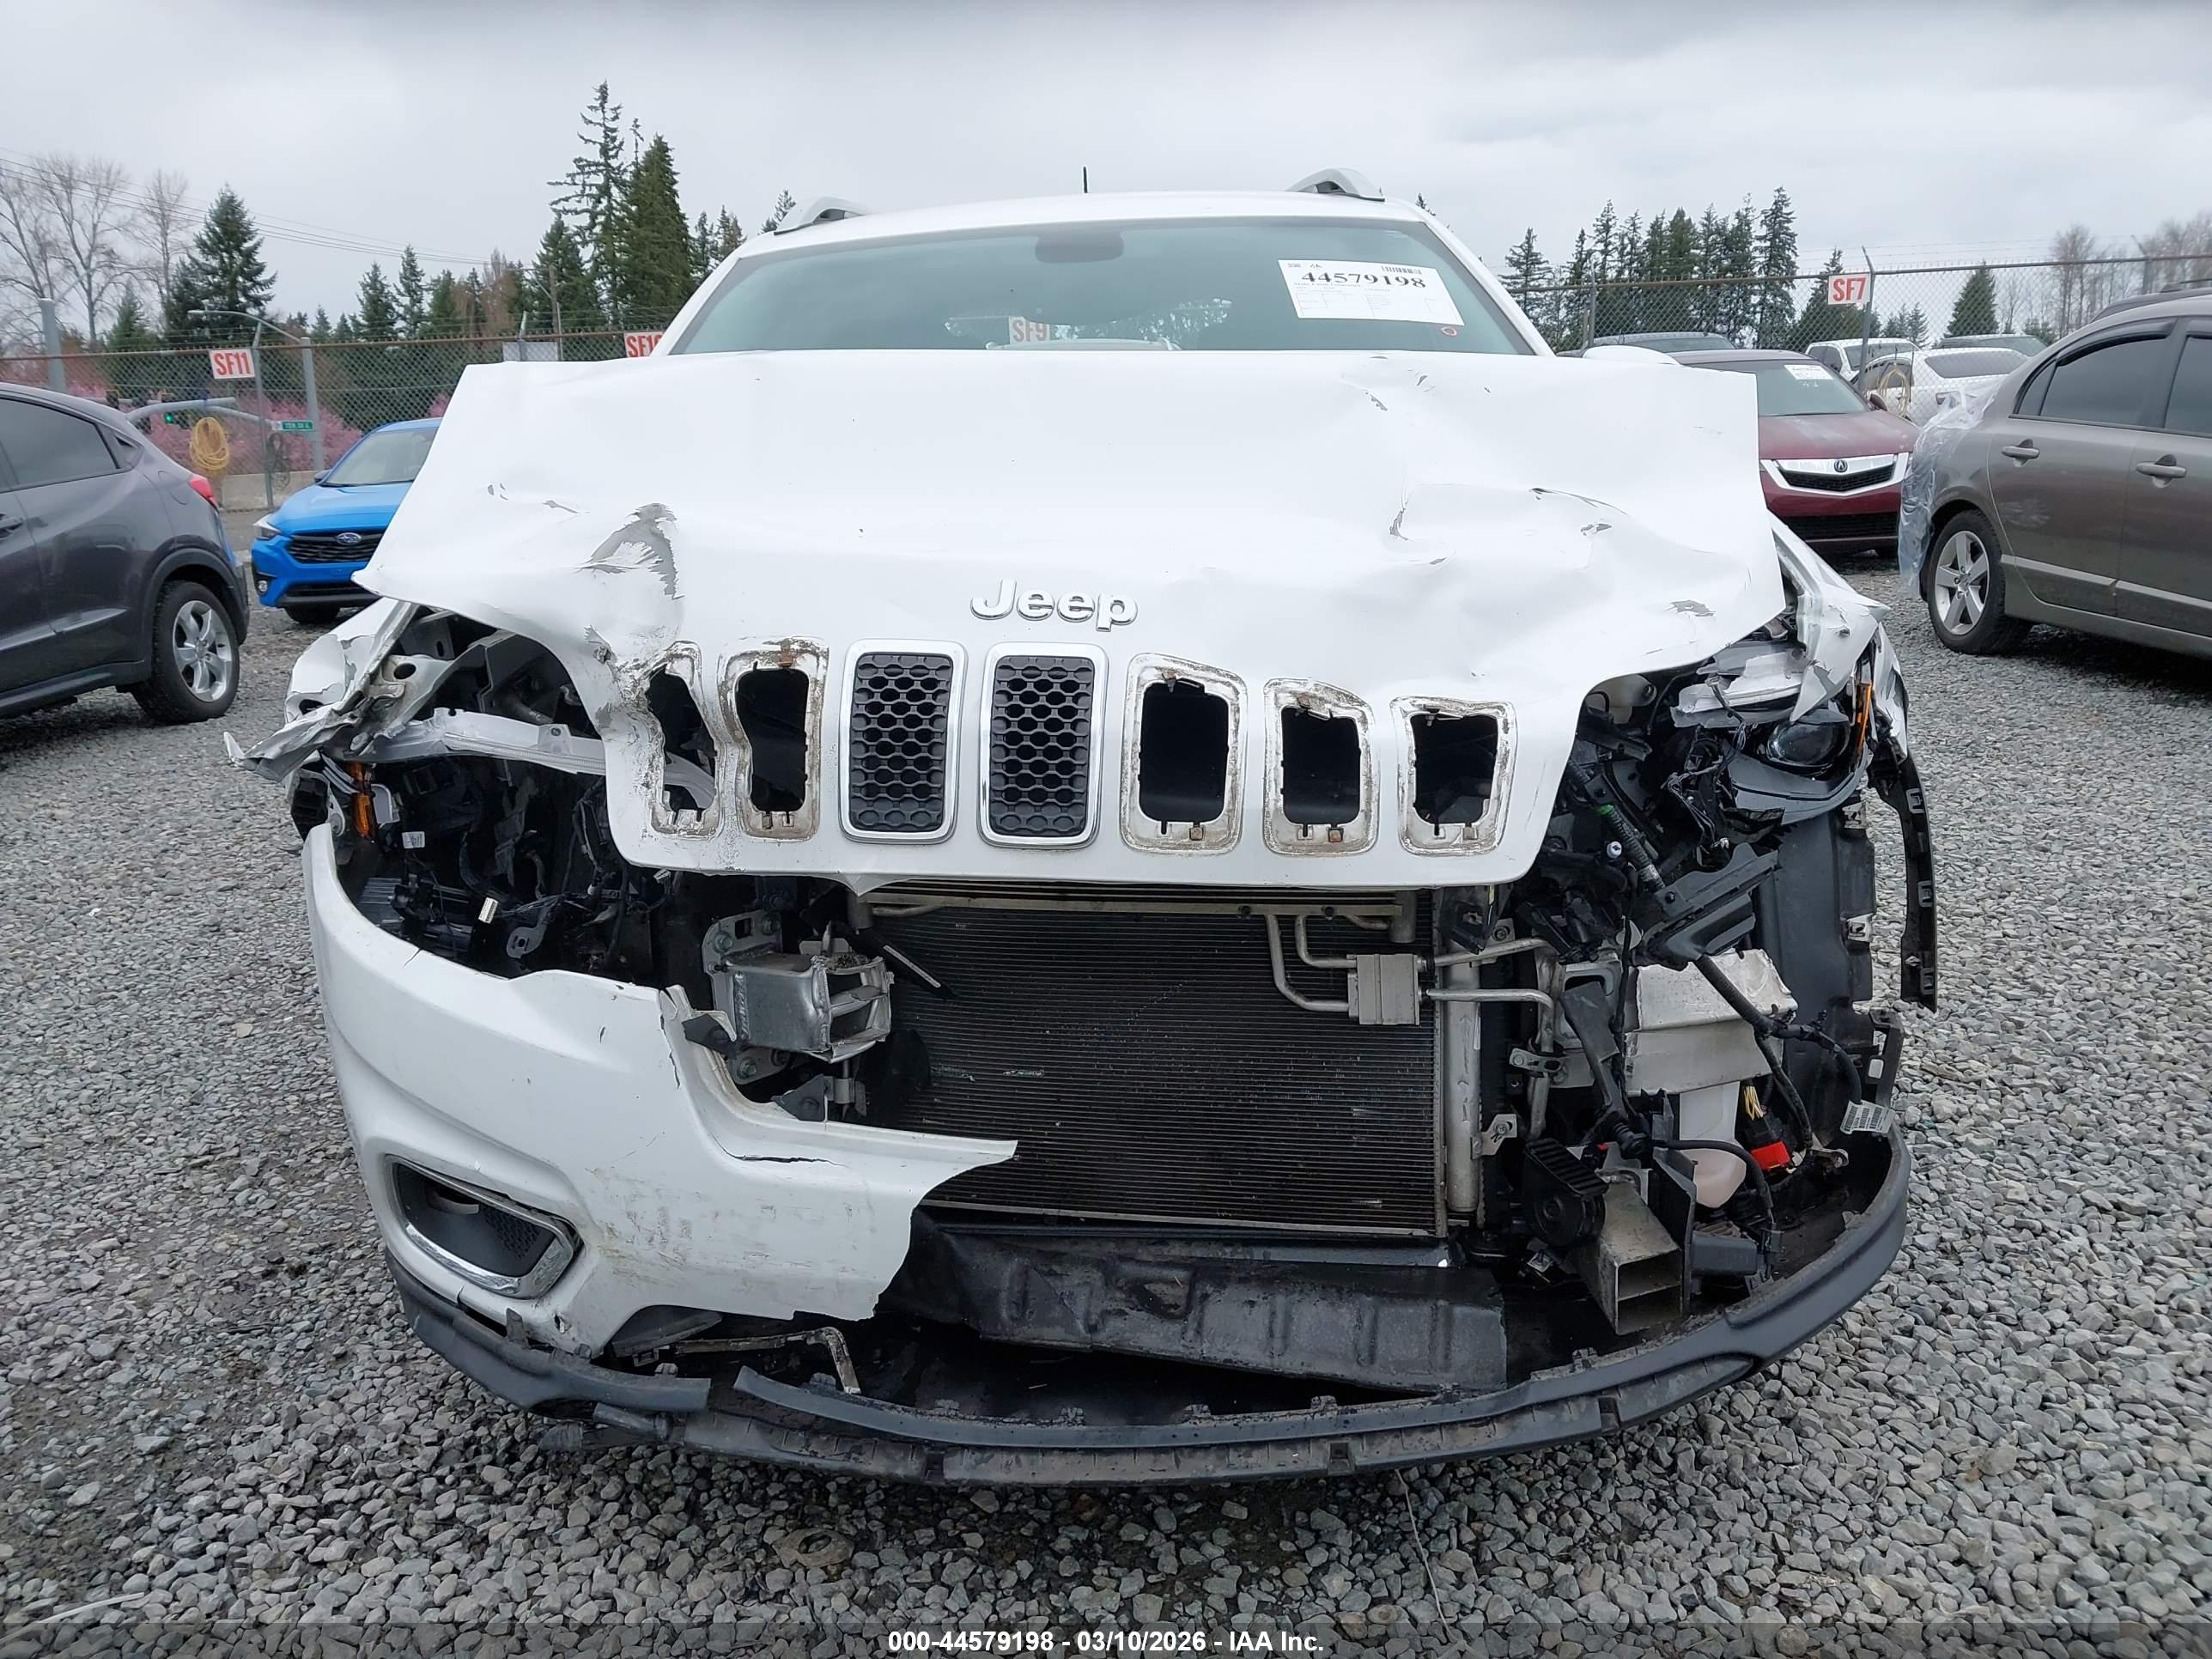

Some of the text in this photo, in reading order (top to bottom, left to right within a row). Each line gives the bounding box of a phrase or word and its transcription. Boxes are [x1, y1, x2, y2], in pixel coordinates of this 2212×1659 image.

[1301, 271, 1426, 288] 44579198
[1832, 277, 1866, 301] SF7
[214, 352, 251, 375] SF11
[969, 578, 1139, 632] Jeep
